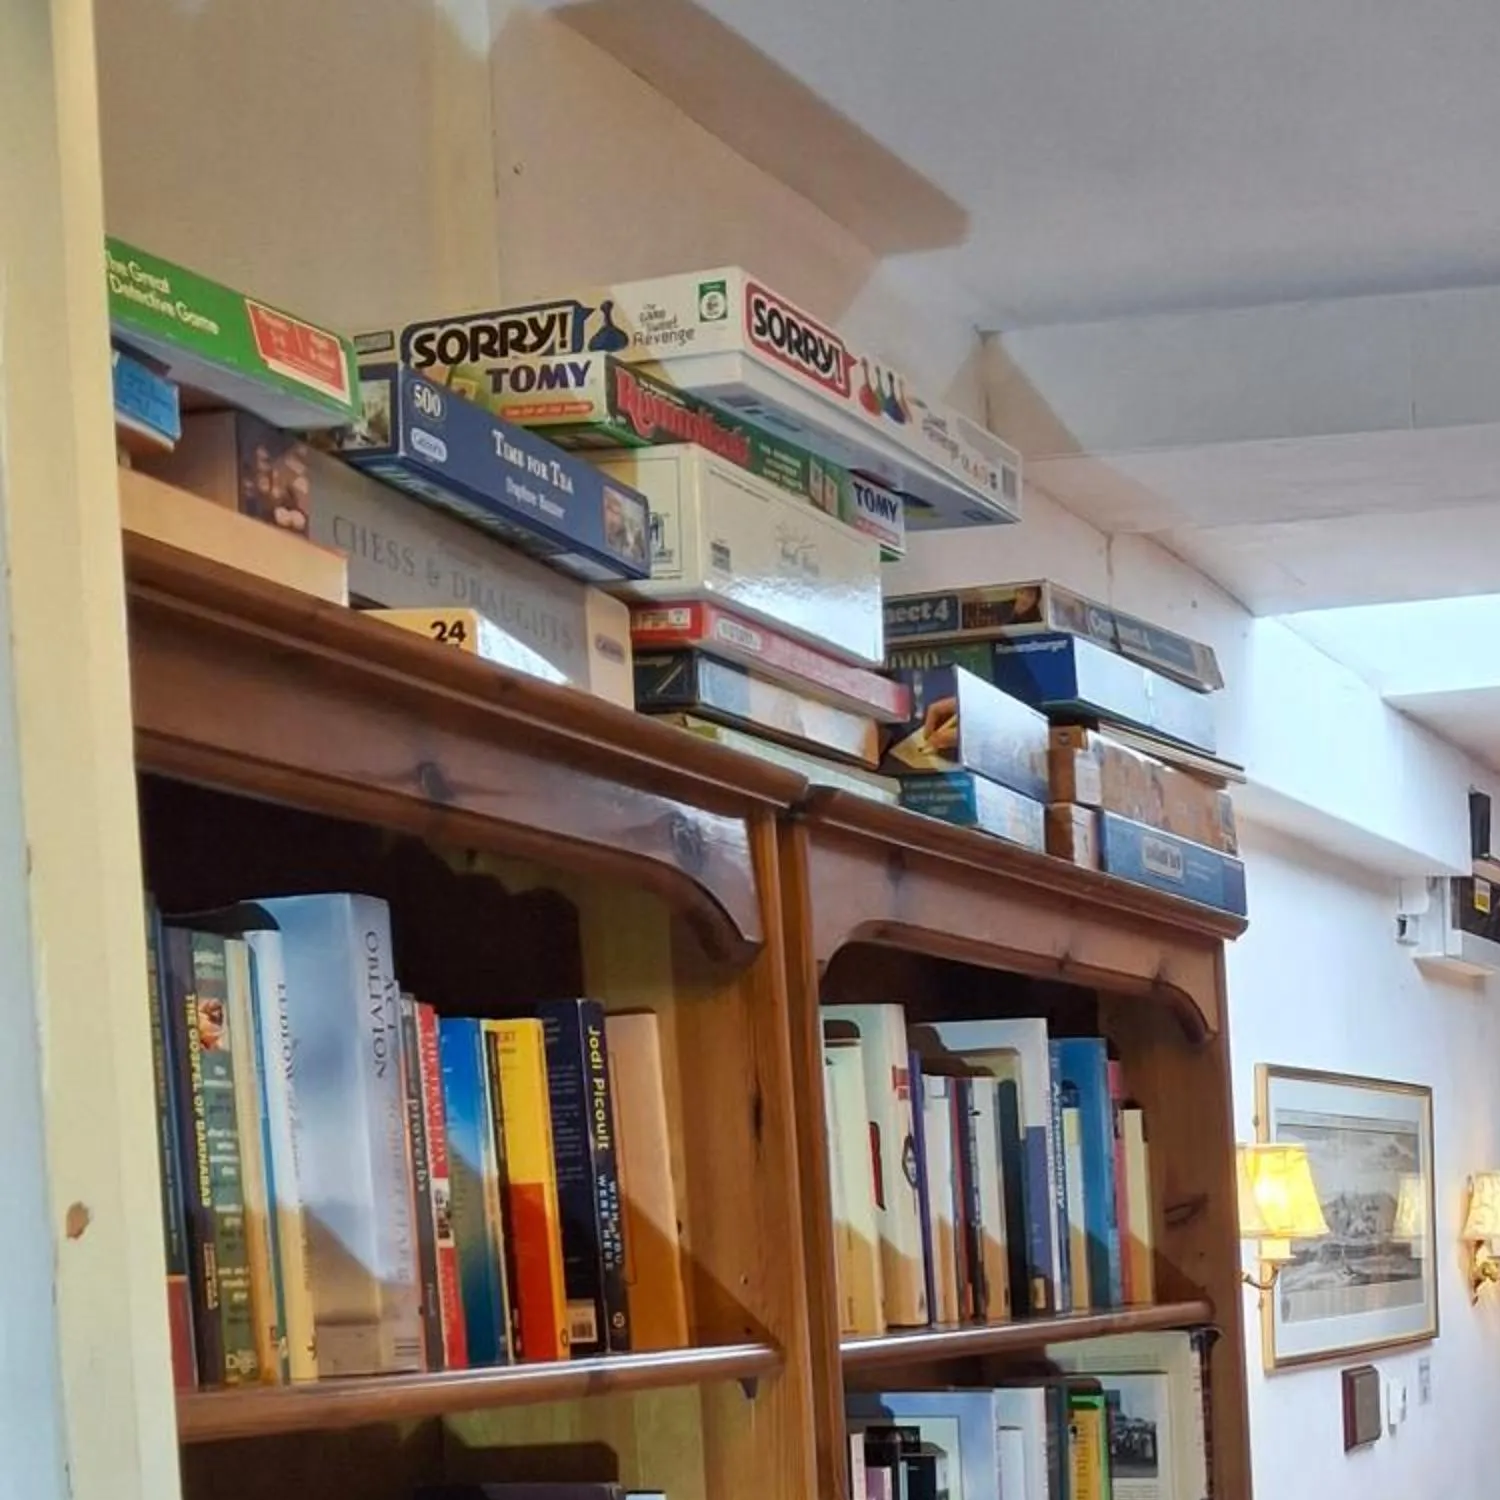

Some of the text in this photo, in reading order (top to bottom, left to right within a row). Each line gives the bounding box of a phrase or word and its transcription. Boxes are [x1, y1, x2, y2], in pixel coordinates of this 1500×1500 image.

[412, 311, 569, 369] SORRY!
[632, 327, 696, 347] Revenge
[753, 298, 843, 386] SORRY!
[412, 383, 443, 418] 500
[486, 360, 592, 394] TOMY
[853, 481, 898, 524] TOMY
[332, 515, 416, 578] CHESS
[430, 620, 466, 643] 24
[184, 992, 197, 1026] THE
[364, 930, 388, 1080] OBLIVION
[189, 1028, 202, 1093] GOSPEL
[193, 1095, 205, 1116] OF
[593, 1076, 610, 1152] Picoult
[406, 1097, 426, 1192] proverbs
